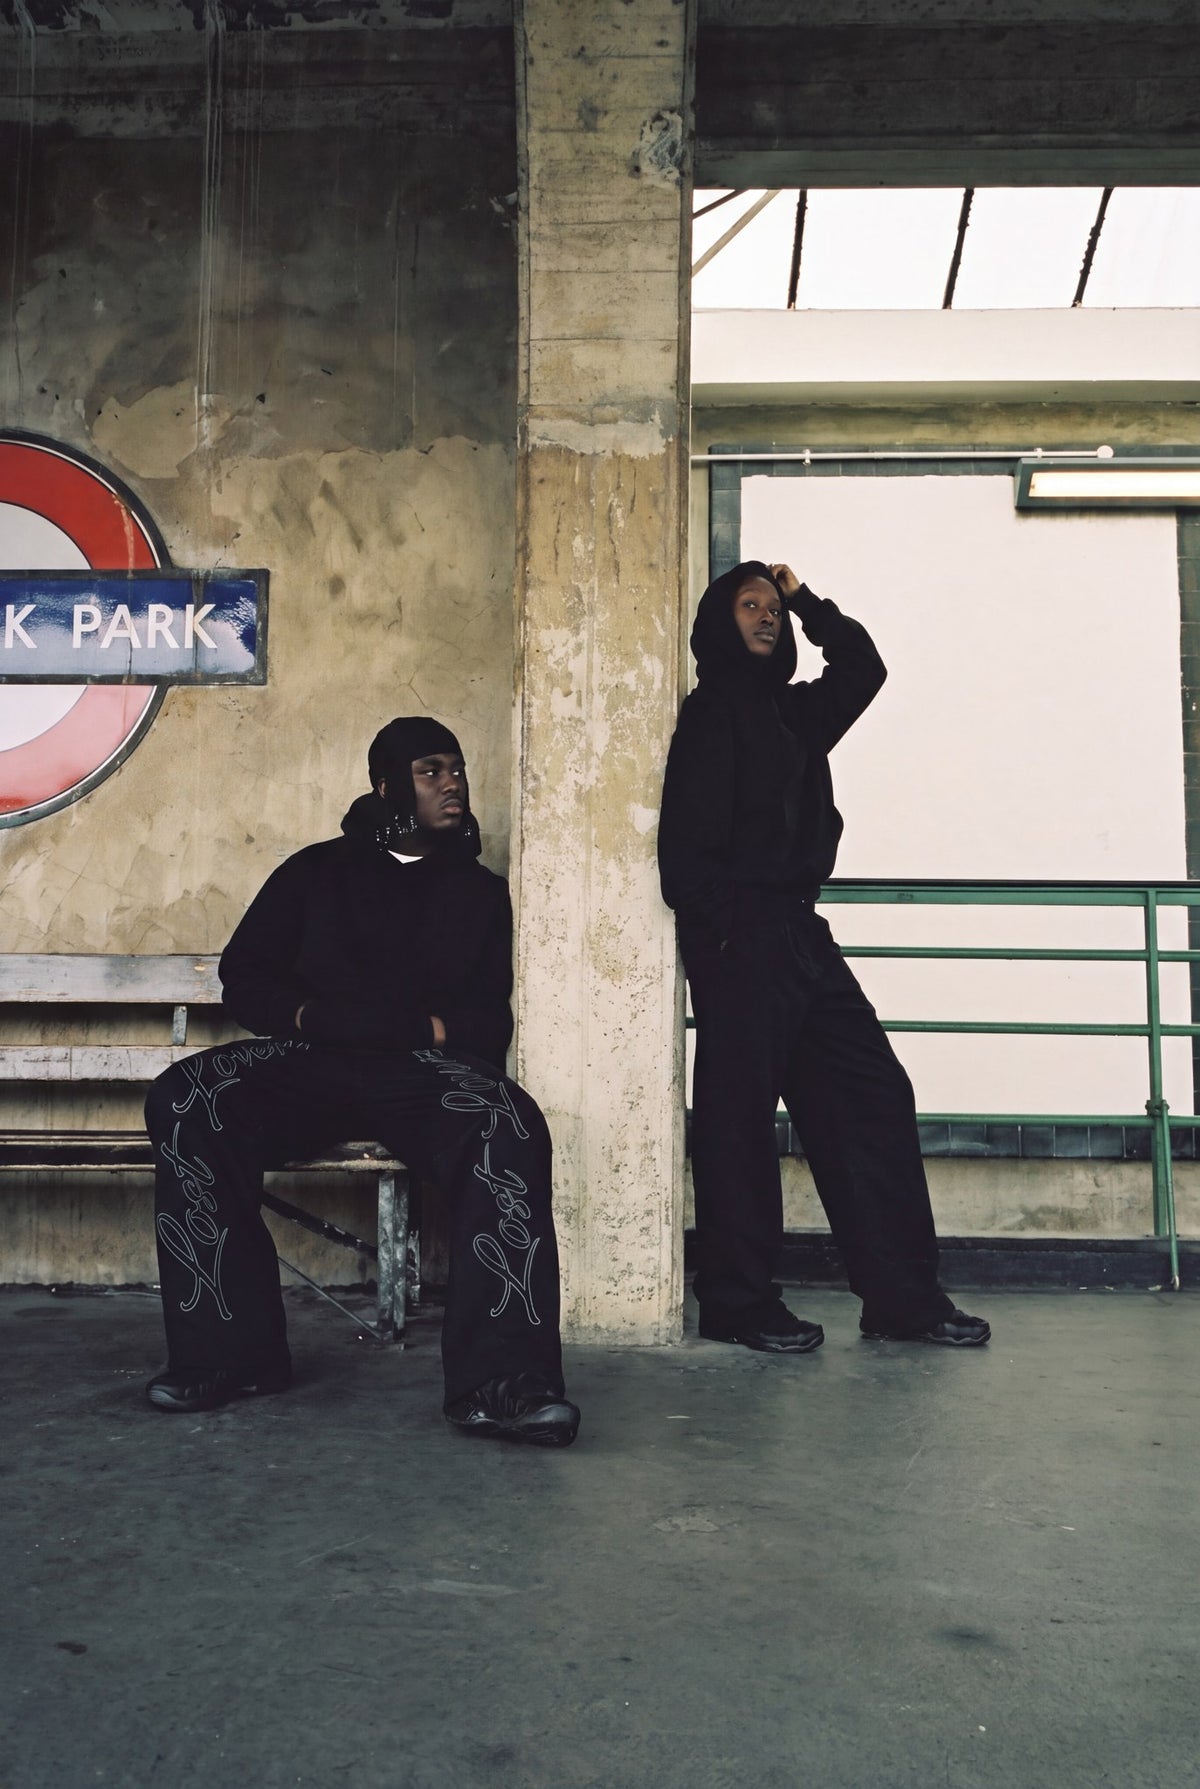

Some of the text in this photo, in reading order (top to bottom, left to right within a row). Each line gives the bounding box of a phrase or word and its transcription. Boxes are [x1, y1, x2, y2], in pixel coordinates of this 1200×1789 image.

[72, 604, 218, 649] PARK
[157, 1121, 232, 1320] Lost
[473, 1142, 541, 1325] Lost
